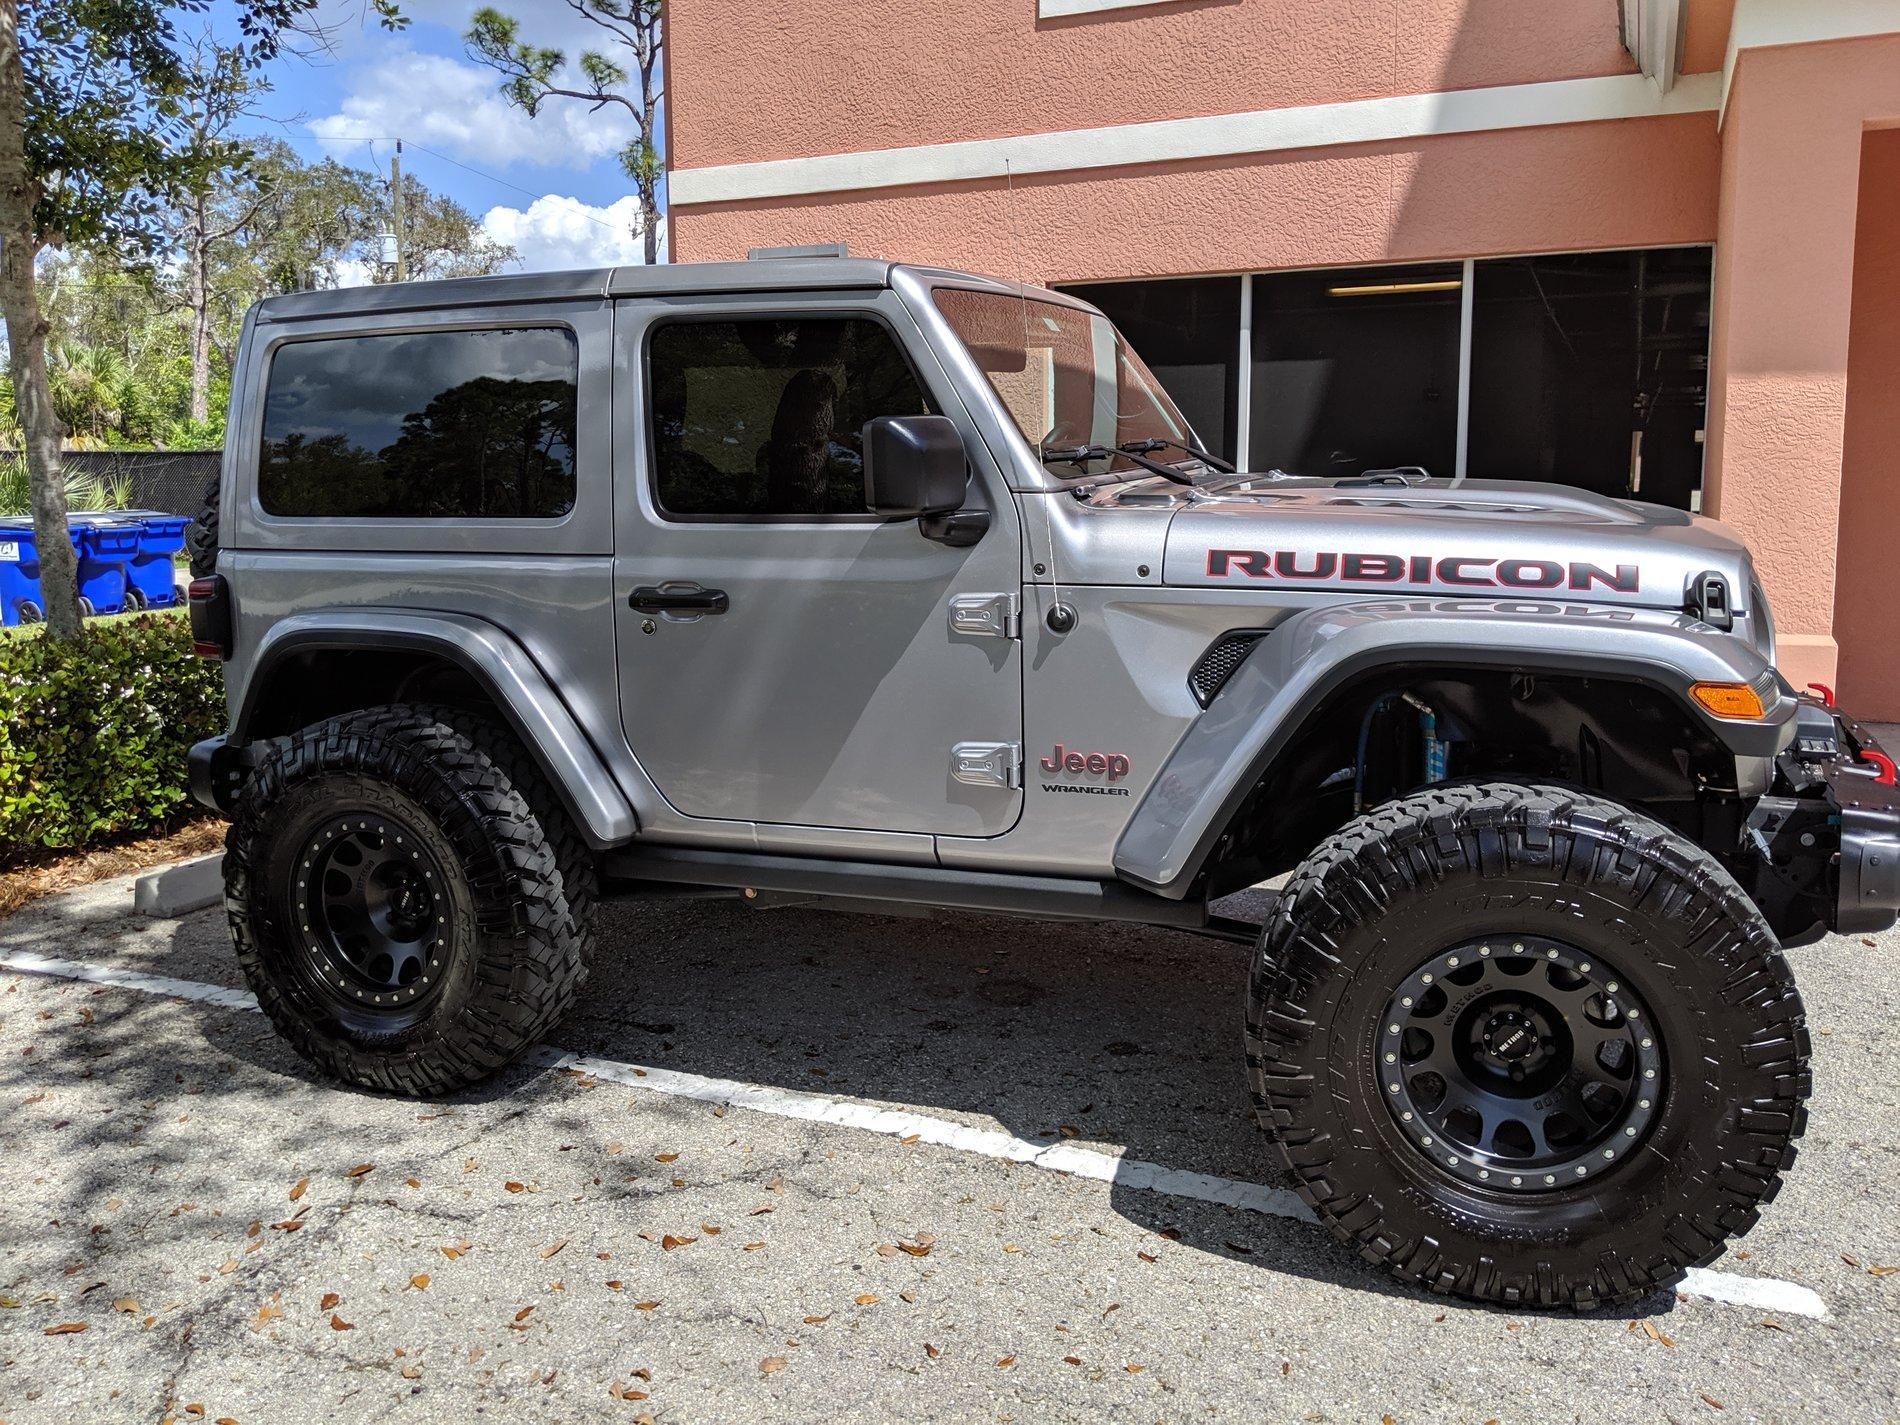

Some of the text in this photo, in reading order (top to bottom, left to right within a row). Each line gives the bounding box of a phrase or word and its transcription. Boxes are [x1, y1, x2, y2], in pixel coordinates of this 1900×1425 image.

[1206, 549, 1640, 593] RUBICON
[1041, 743, 1130, 781] Jeep
[1041, 784, 1131, 797] WRANGLER
[1499, 1029, 1525, 1053] METHOD
